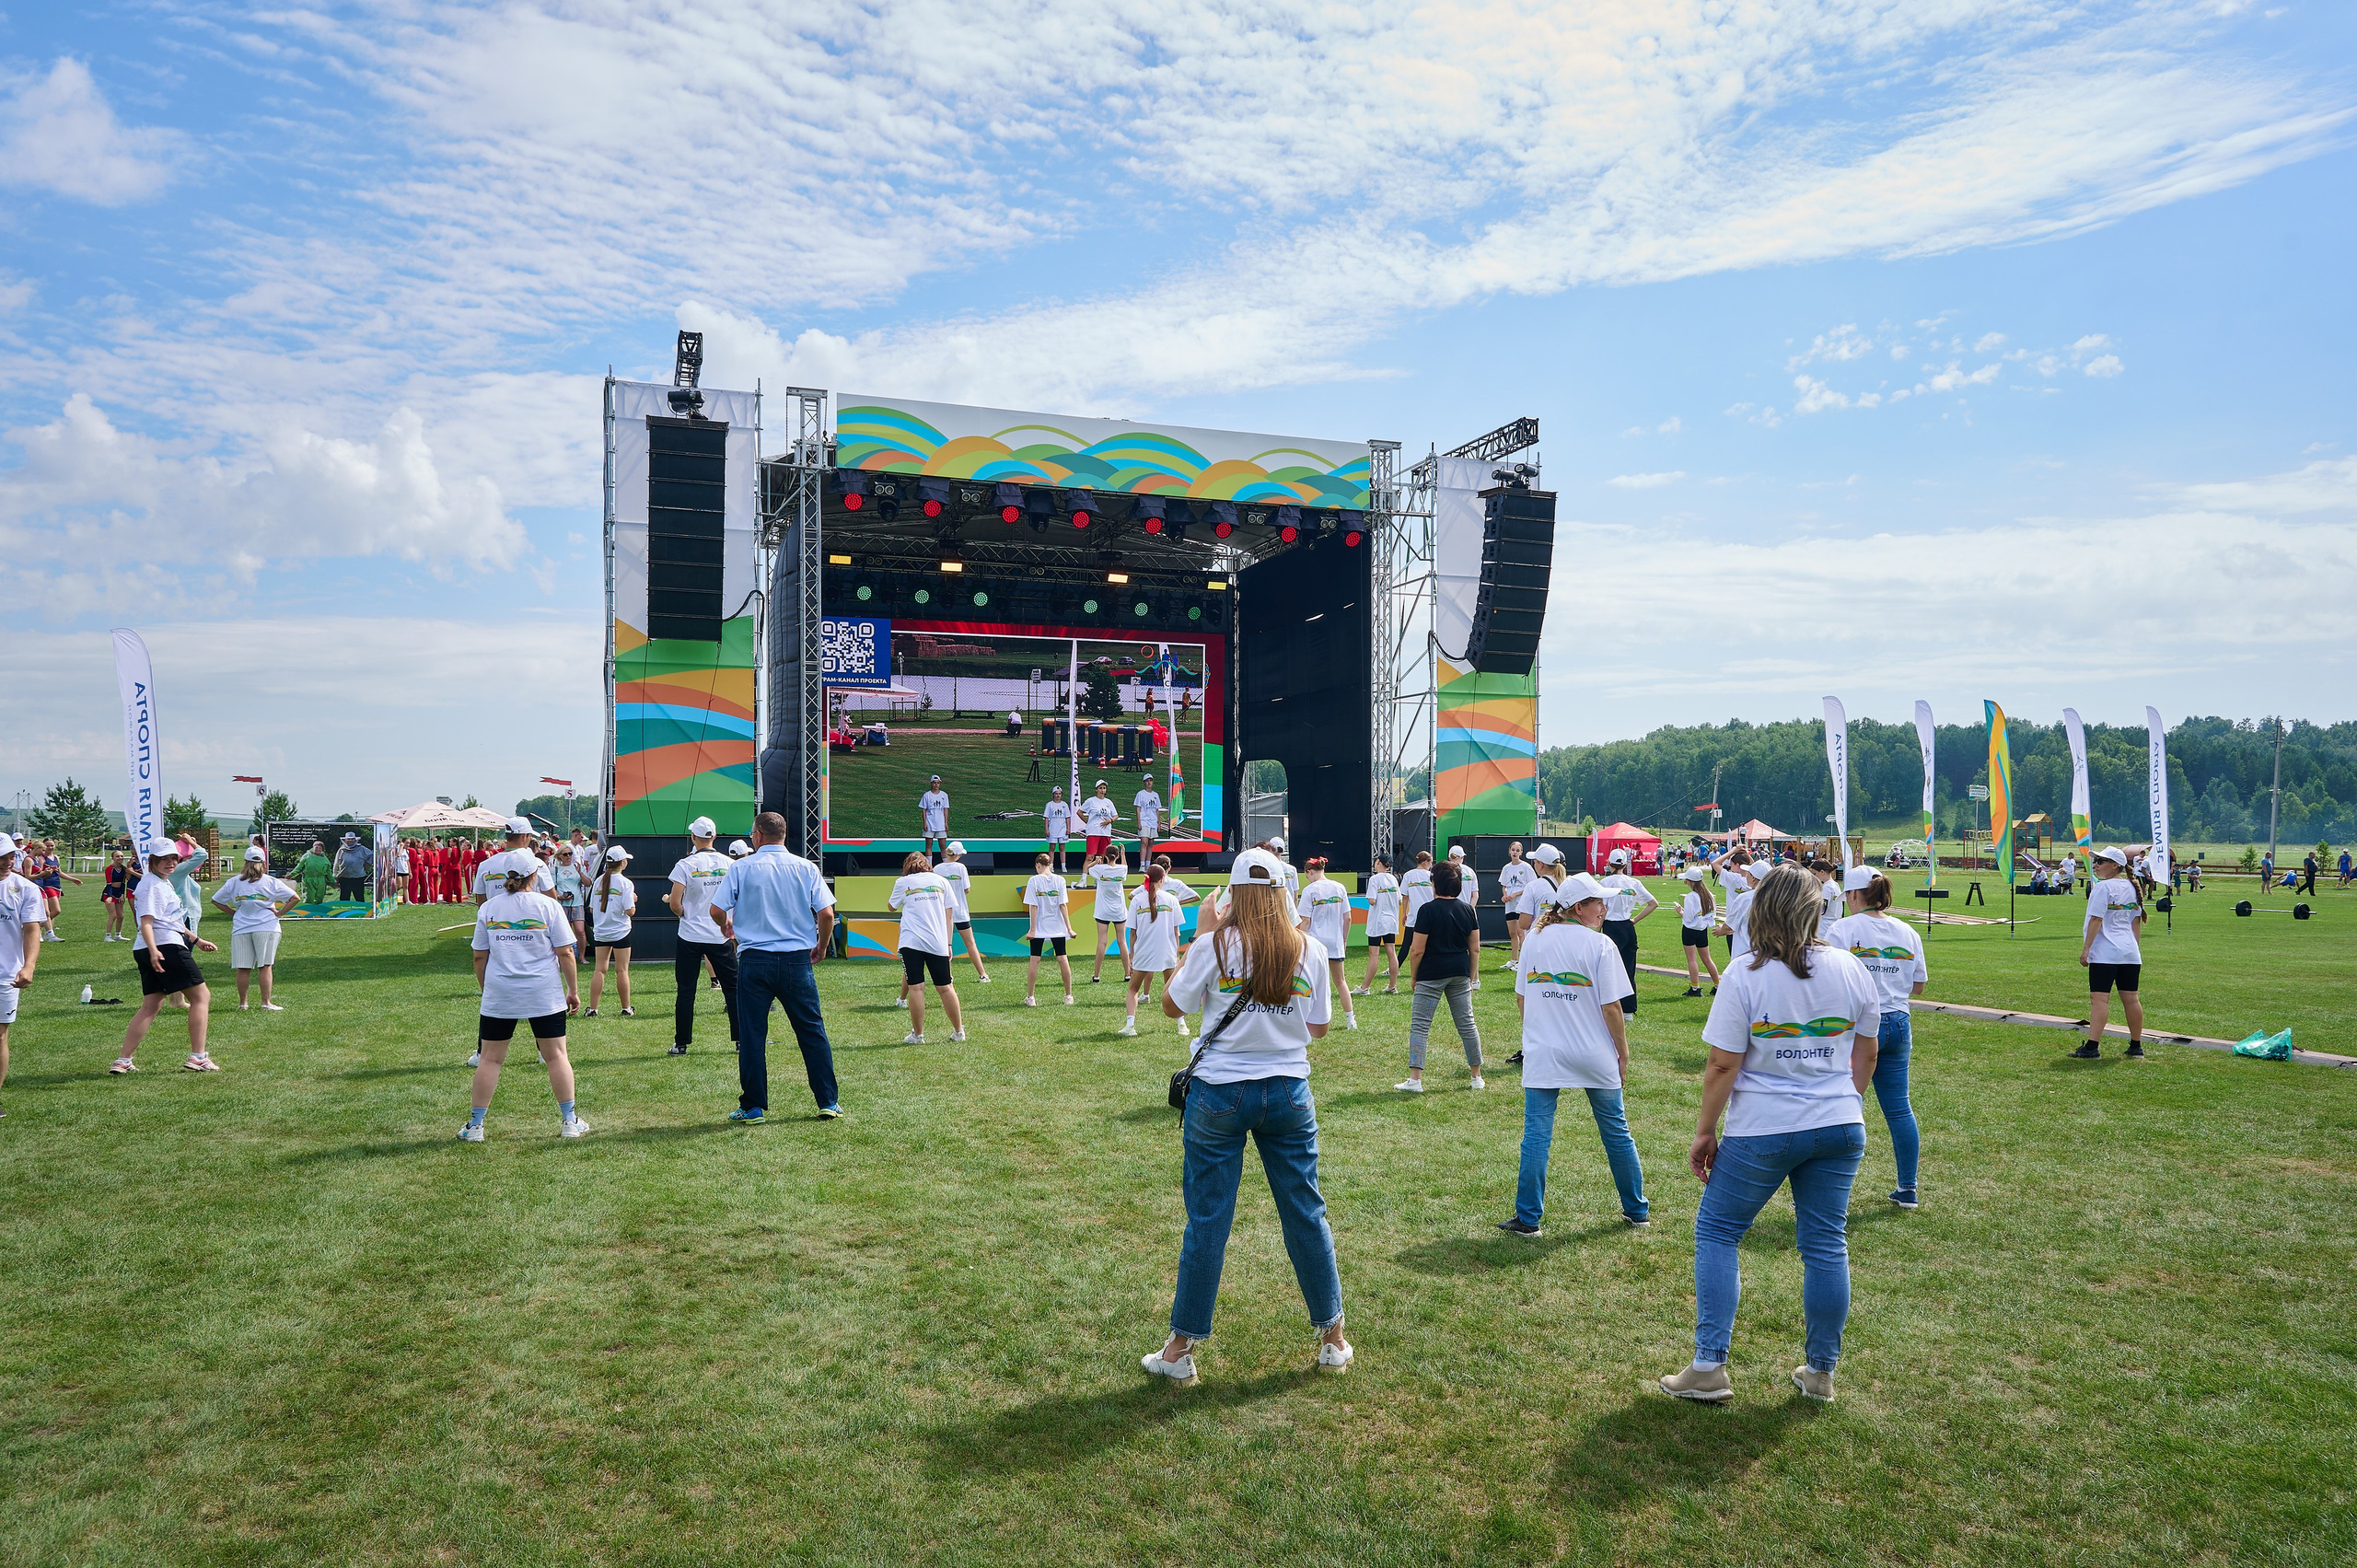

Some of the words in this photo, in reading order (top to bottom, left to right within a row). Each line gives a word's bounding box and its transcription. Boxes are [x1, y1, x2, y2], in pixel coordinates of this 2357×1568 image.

[822, 676, 860, 684] РАМ-КАНАЛ
[258, 786, 265, 796] 6
[566, 789, 573, 799] 5
[1227, 993, 1250, 1018] GUESS
[1776, 1046, 1835, 1059] ВОЛОНТЁР
